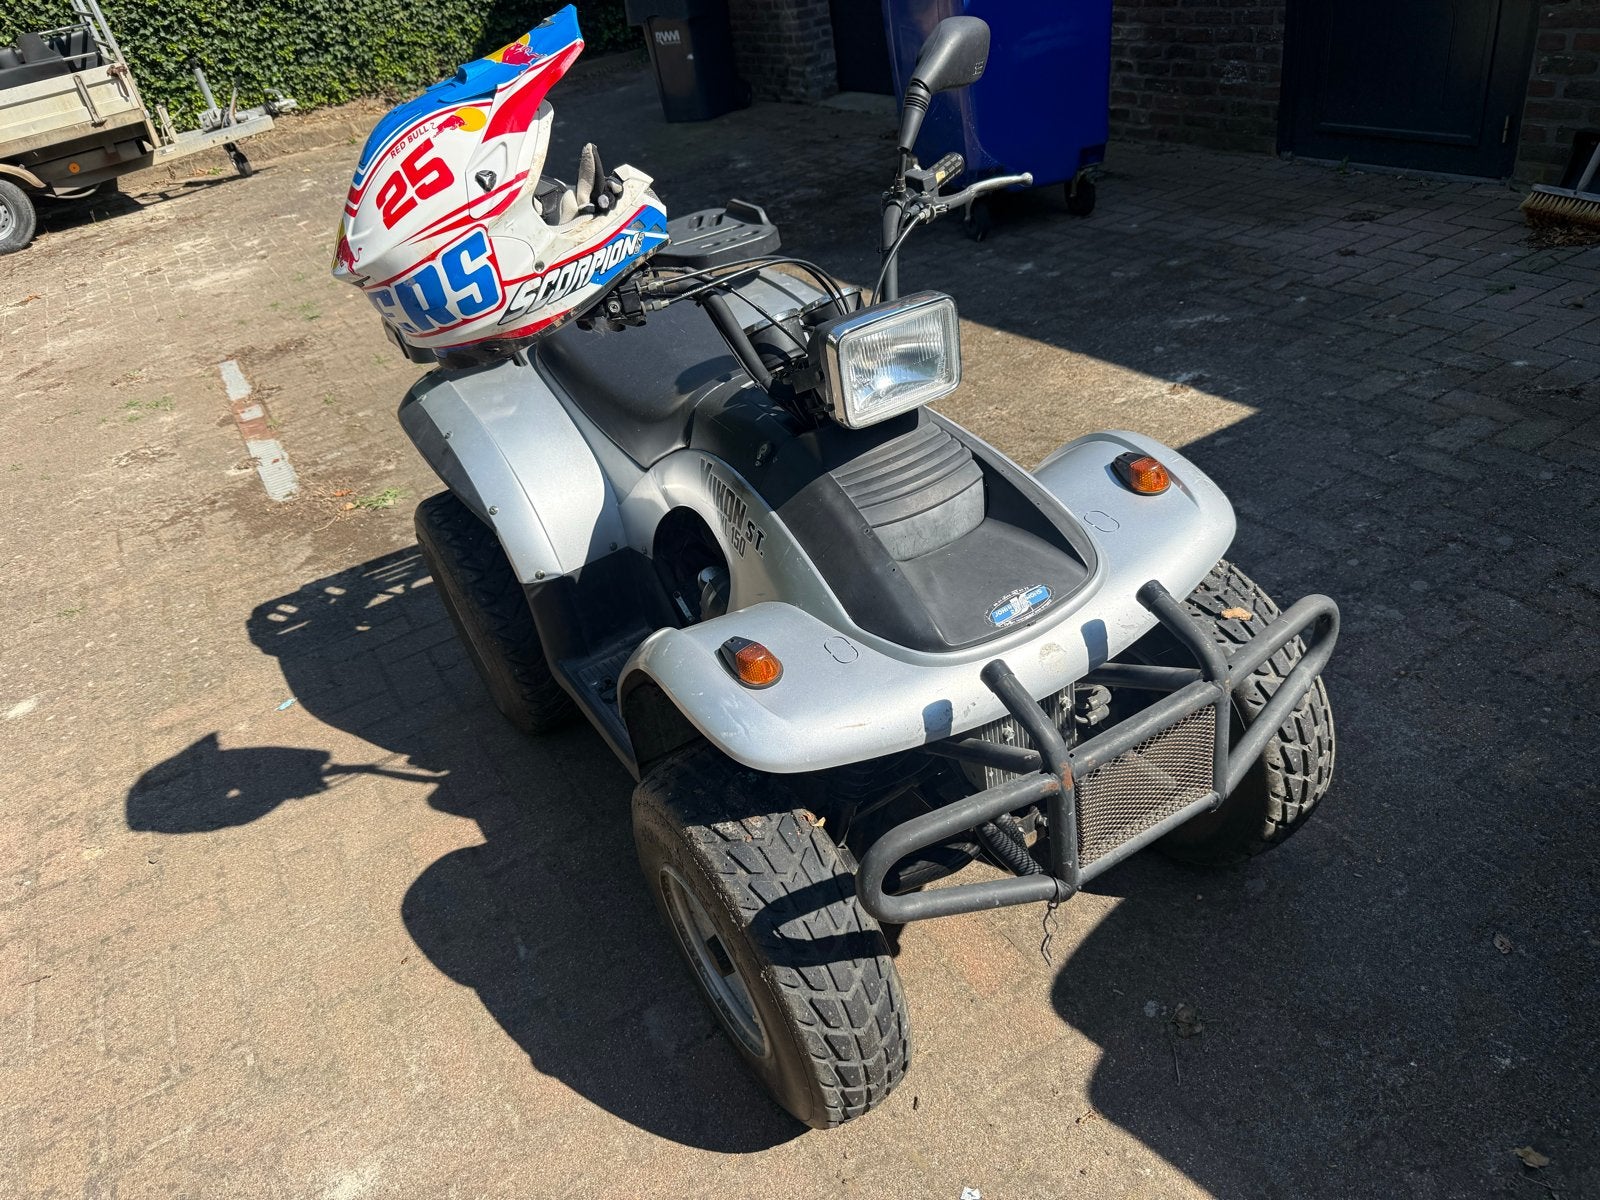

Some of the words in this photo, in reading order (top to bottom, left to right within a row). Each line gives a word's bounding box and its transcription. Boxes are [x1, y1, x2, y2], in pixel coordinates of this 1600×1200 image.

[390, 142, 406, 159] RED
[407, 125, 429, 143] BULL
[376, 138, 455, 230] 25
[498, 232, 640, 325] SCORPION
[731, 526, 747, 558] 150
